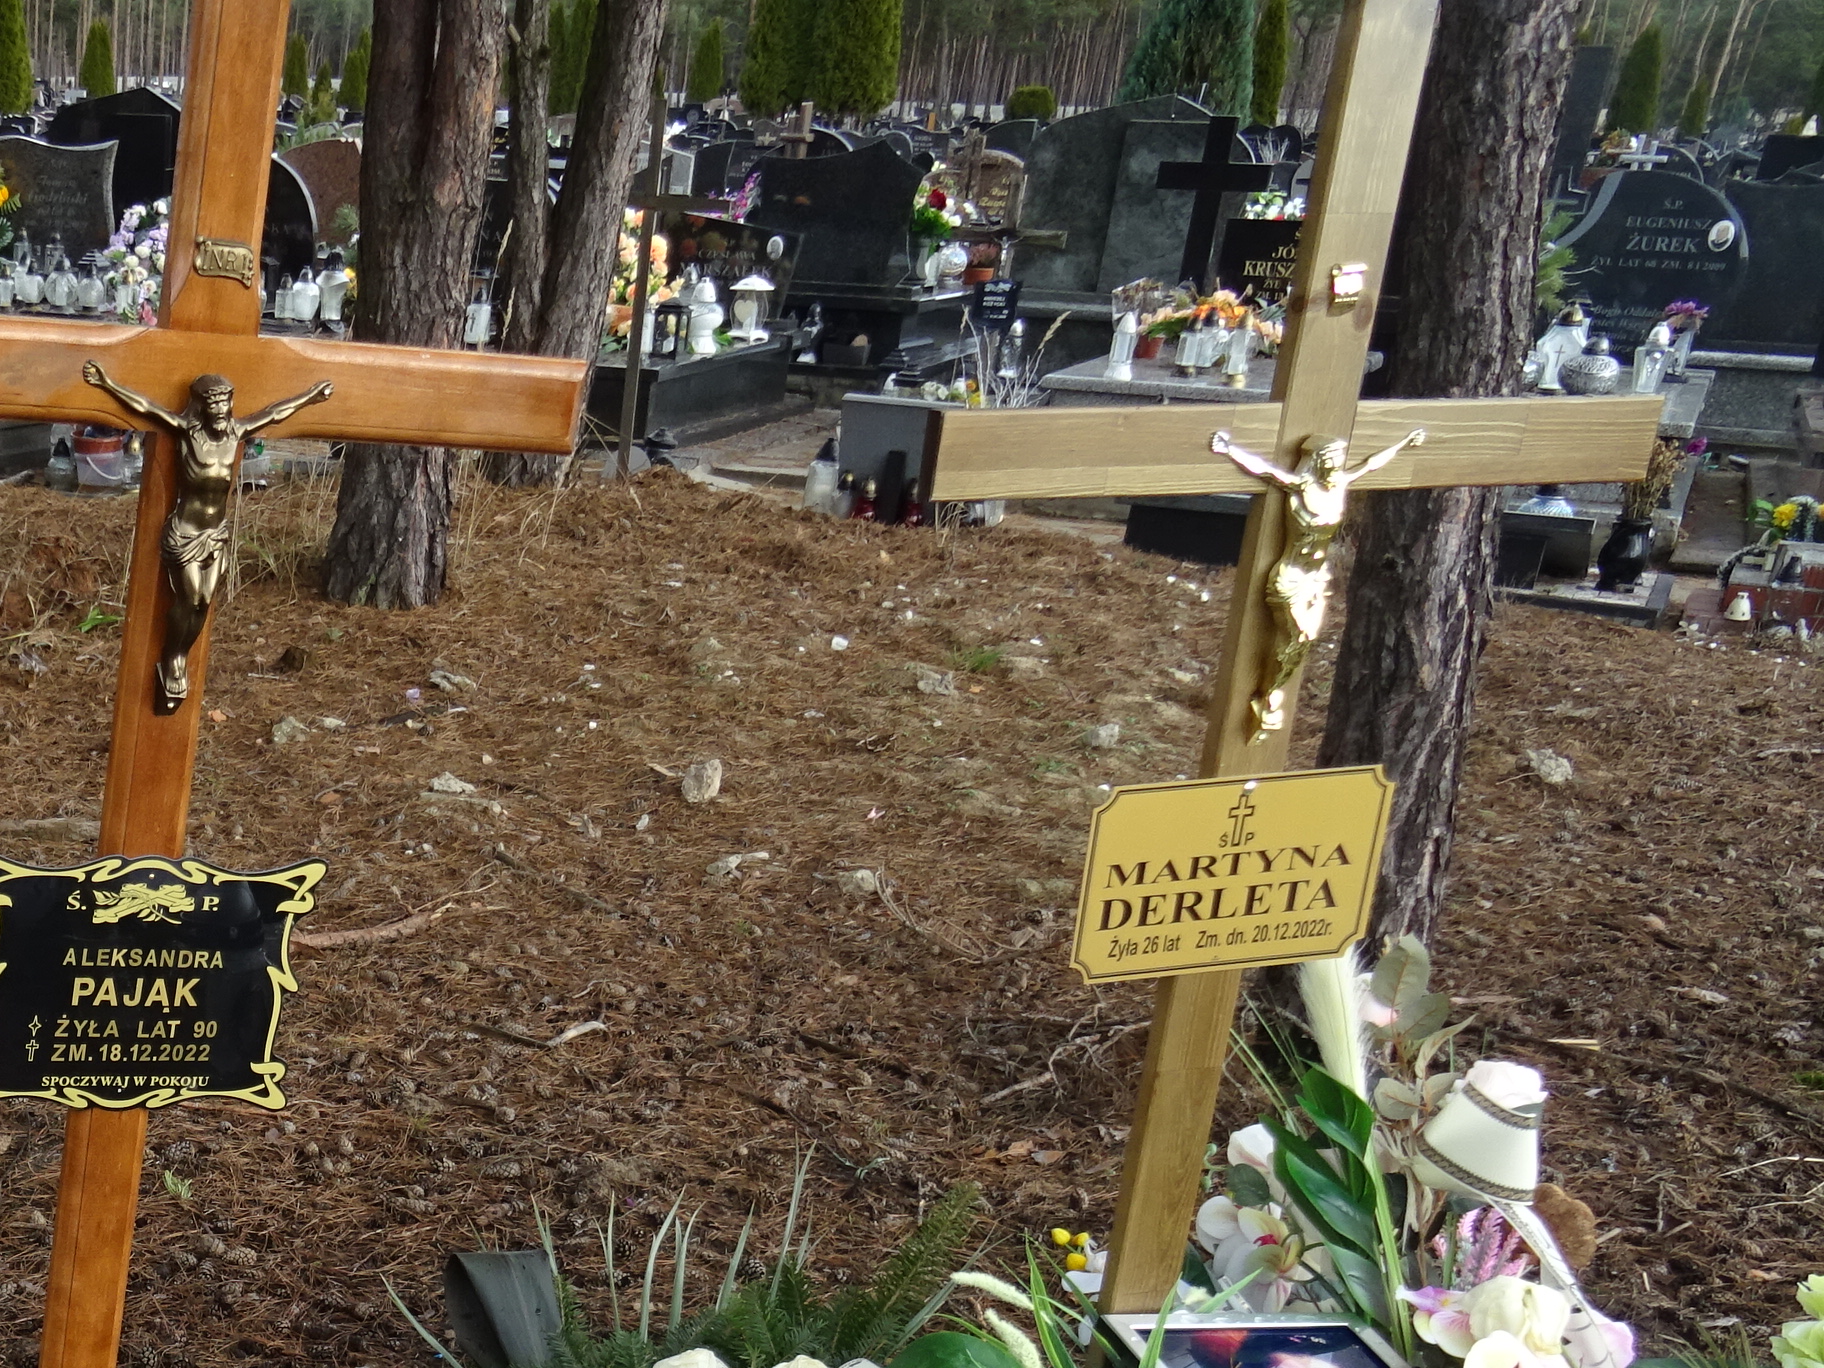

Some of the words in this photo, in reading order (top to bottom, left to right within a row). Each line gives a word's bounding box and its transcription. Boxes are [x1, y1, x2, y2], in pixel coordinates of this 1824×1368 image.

[1626, 216, 1713, 230] EUGENIUSZ
[1626, 232, 1701, 253] ŻUREK
[1243, 260, 1297, 279] KRUSZ
[1104, 842, 1351, 888] MARTYNA
[1096, 878, 1338, 931] DERLETA
[1107, 934, 1138, 962] Żyła
[1142, 936, 1159, 954] 26
[1162, 934, 1180, 952] lat
[1196, 930, 1221, 949] Zm.
[1226, 926, 1247, 946] dn.
[1251, 918, 1332, 943] 20.12.2022r.
[63, 948, 223, 969] ALEKSANDRA
[71, 978, 201, 1013] PAJĄK
[54, 1014, 119, 1039] ŻYŁA
[137, 1020, 181, 1039] LAT
[193, 1020, 218, 1039] 90
[41, 1075, 129, 1089] SPOCZYWAJ
[133, 1076, 147, 1087] W
[149, 1075, 210, 1089] POKOJU
